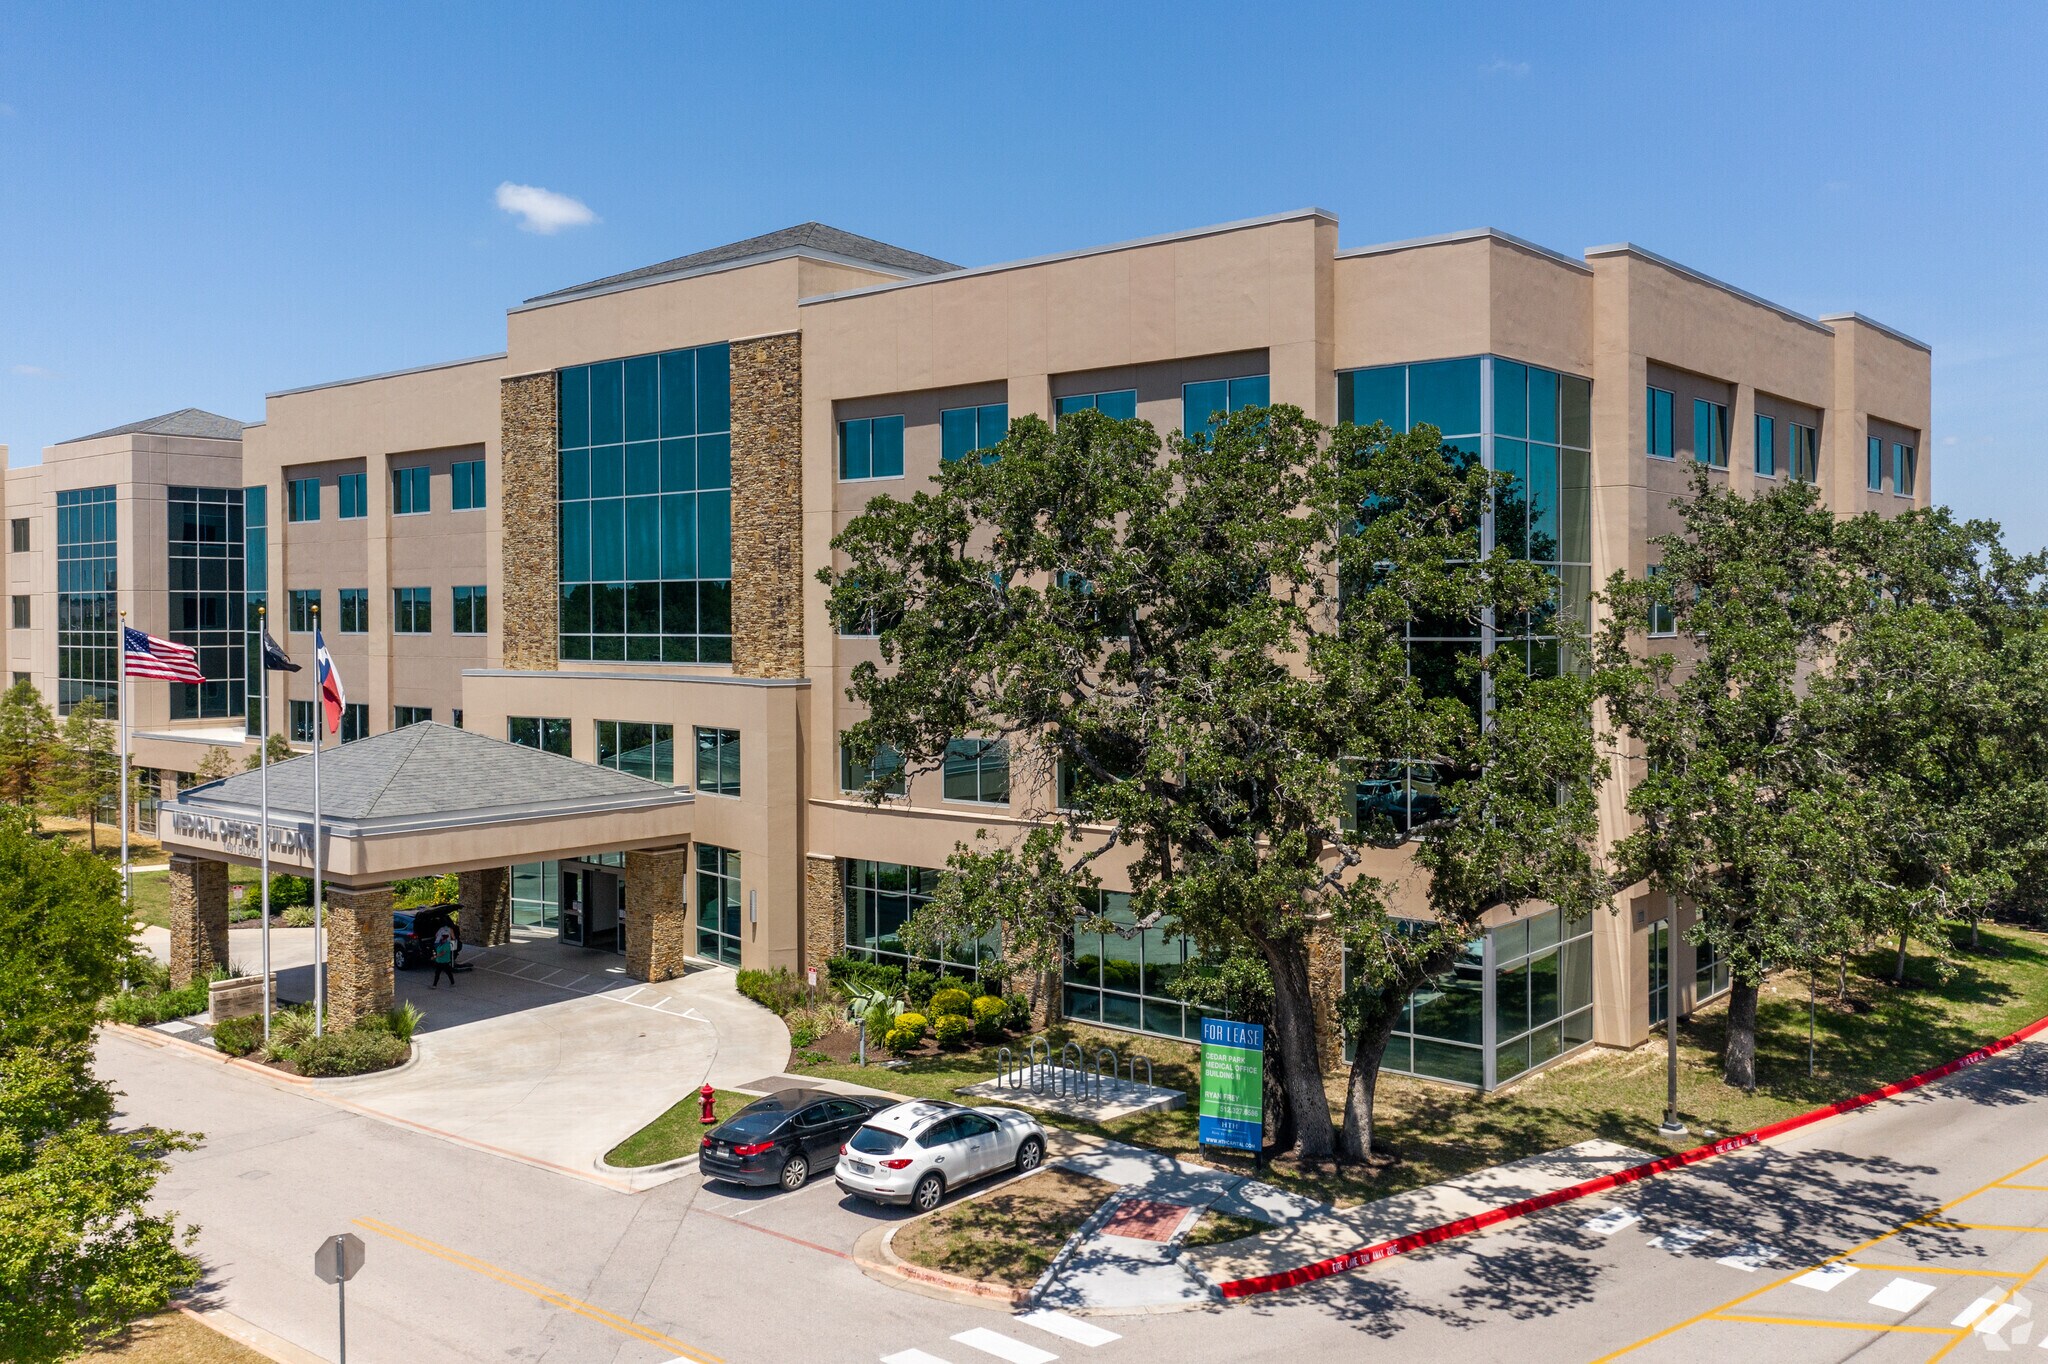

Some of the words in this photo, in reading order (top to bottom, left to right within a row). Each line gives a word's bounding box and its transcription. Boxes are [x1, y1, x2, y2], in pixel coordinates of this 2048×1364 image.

[172, 812, 216, 835] MEDICAL
[219, 820, 259, 841] OFFICE
[264, 826, 315, 850] UILDING
[238, 844, 257, 858] BLDG
[1204, 1023, 1223, 1041] FOR
[1226, 1026, 1260, 1046] LEASE
[1205, 1052, 1227, 1062] CEDAR
[1228, 1055, 1246, 1063] PARK
[1205, 1060, 1233, 1071] MEDICAL
[1235, 1064, 1258, 1075] OFFICE
[1205, 1069, 1235, 1080] BUILDING
[1204, 1090, 1222, 1100] RYAN
[1223, 1093, 1240, 1102] FREY
